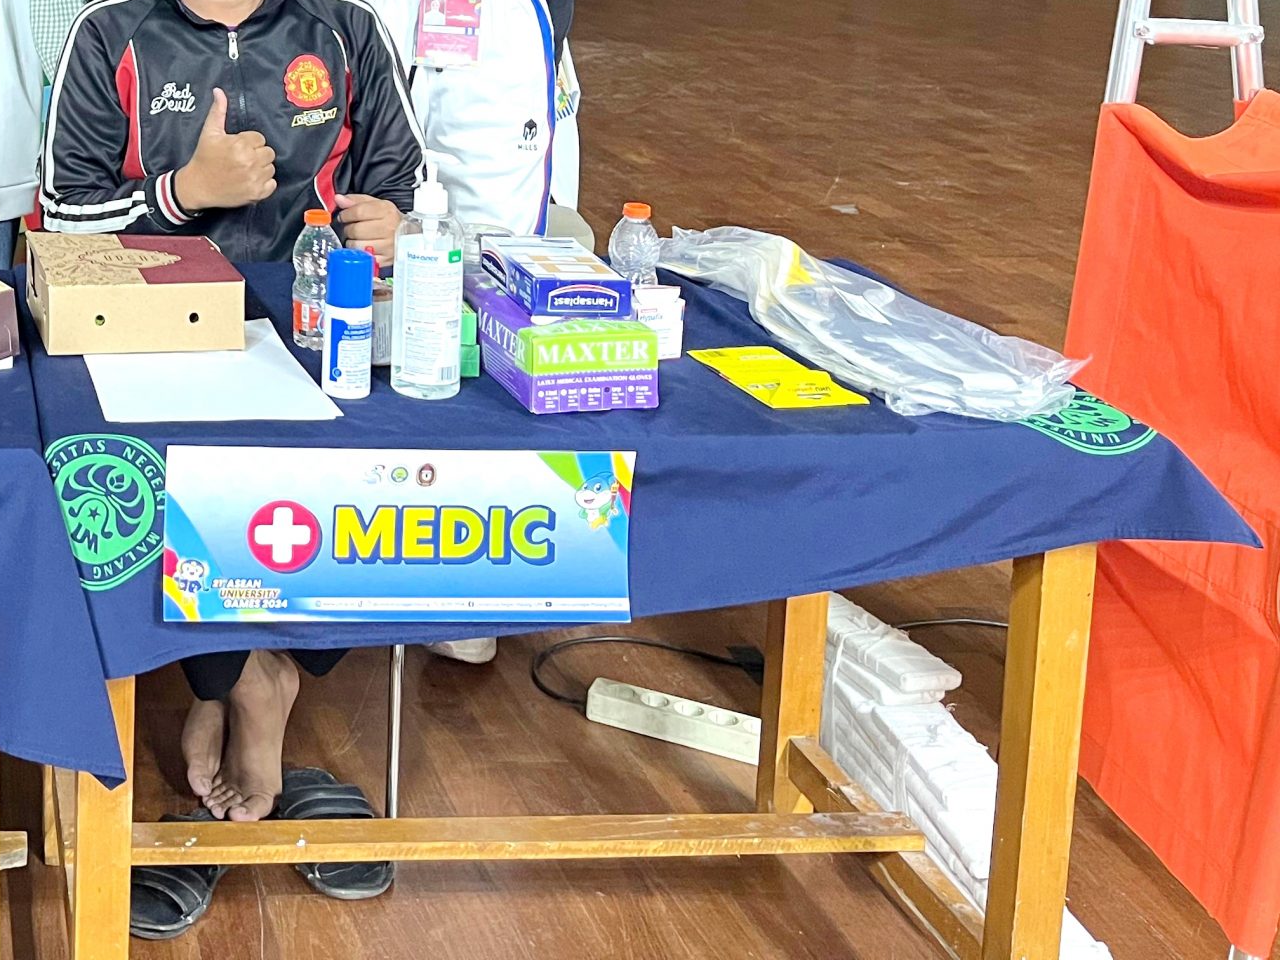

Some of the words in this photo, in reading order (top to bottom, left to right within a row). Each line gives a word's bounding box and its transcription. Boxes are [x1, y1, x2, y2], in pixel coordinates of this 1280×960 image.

[162, 82, 192, 99] Red
[553, 296, 613, 307] Hansaplast
[538, 340, 650, 365] MAXTER
[52, 440, 106, 478] SITAS
[333, 505, 554, 563] MEDIC
[93, 531, 160, 579] MALANG
[227, 579, 261, 589] ASEAN
[220, 589, 279, 598] UNIVERSITY
[224, 599, 260, 609] GAMES
[262, 599, 288, 609] 2024
